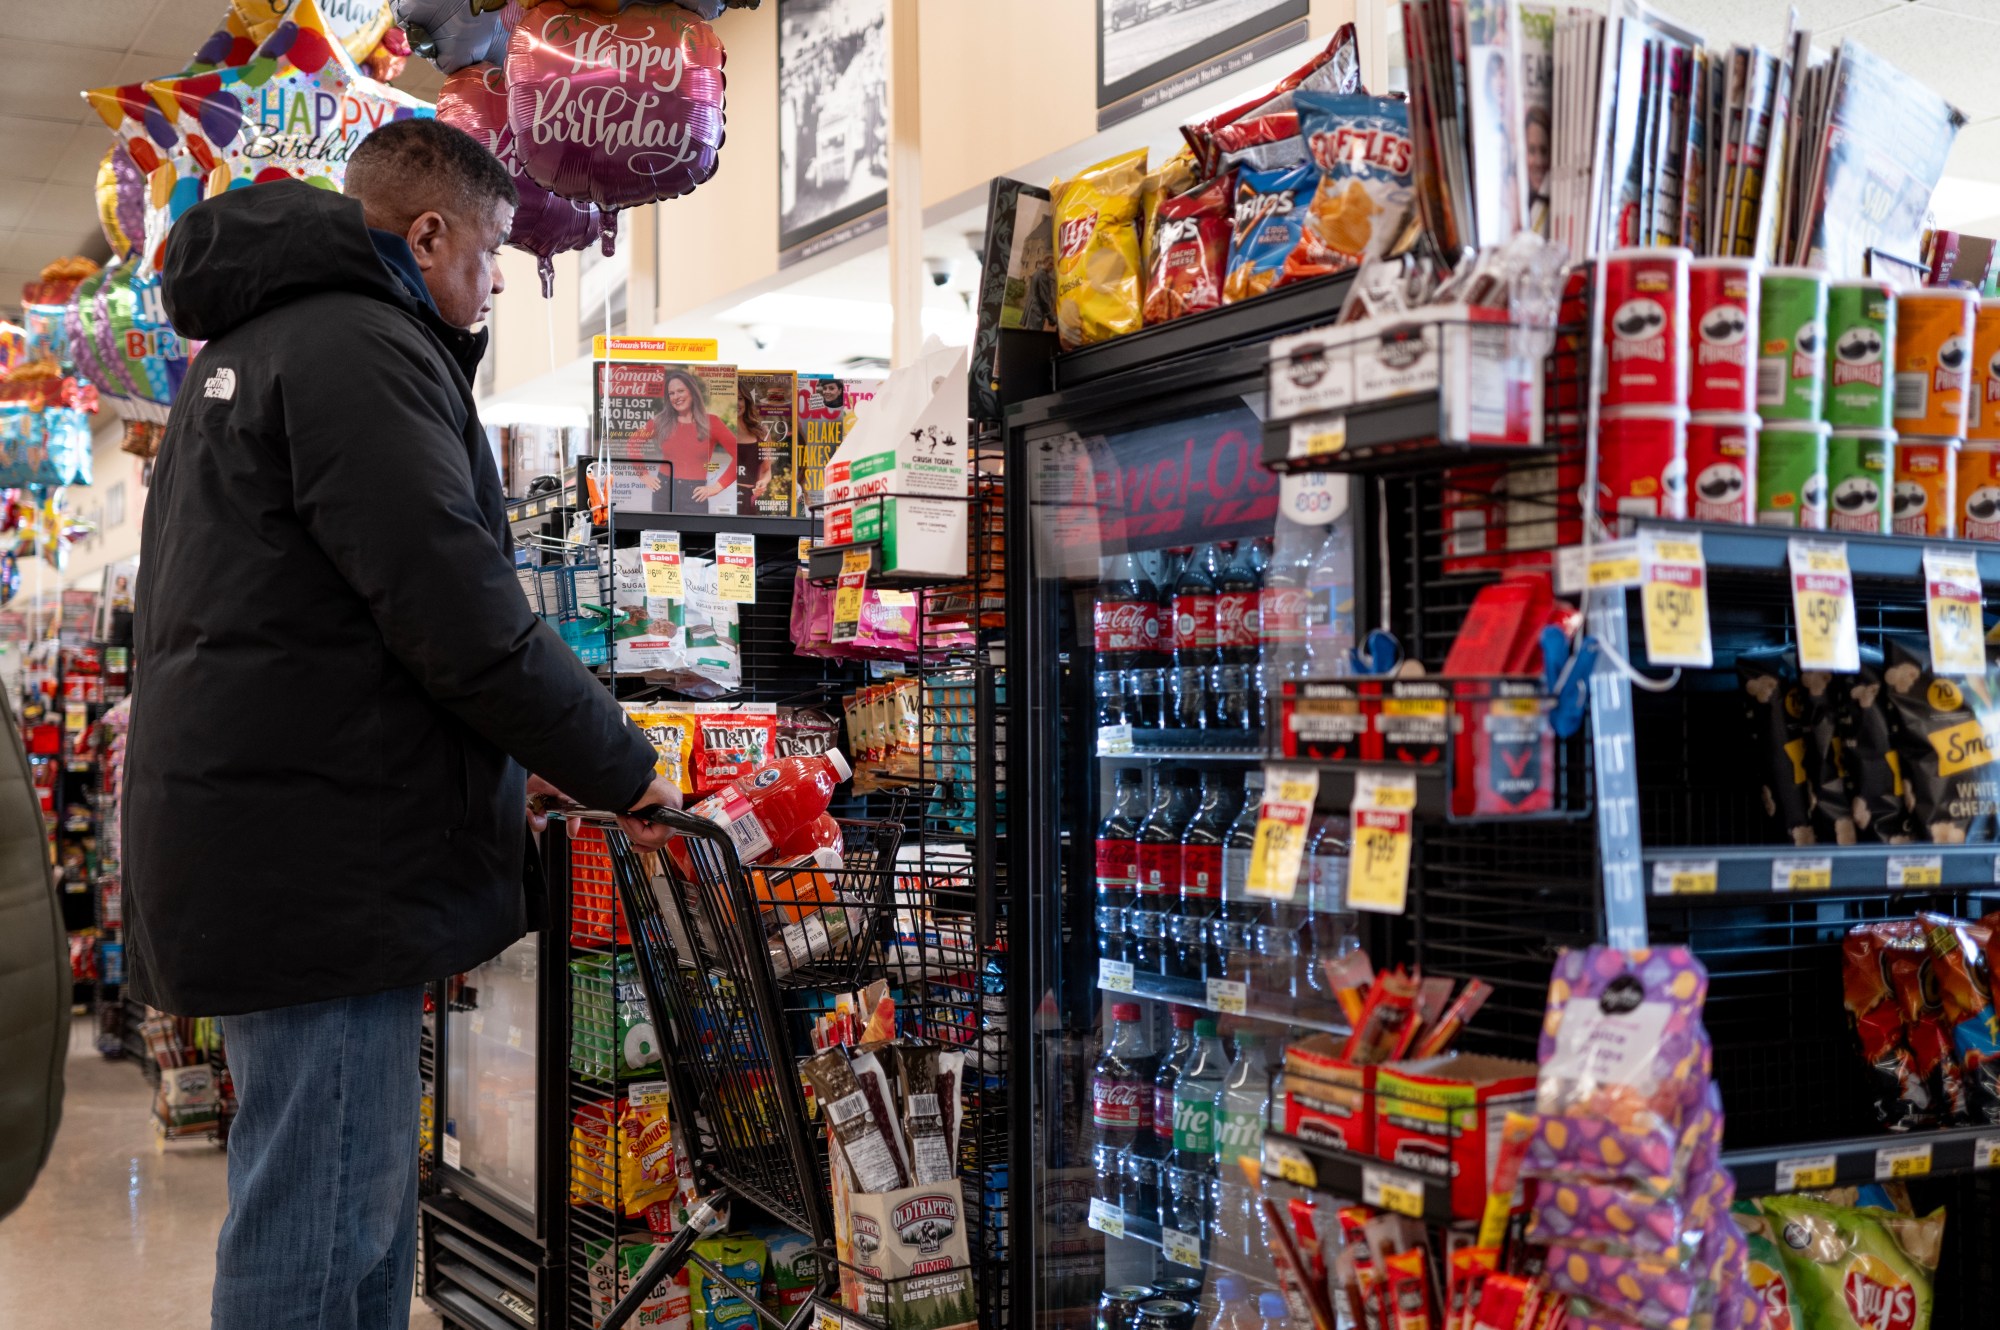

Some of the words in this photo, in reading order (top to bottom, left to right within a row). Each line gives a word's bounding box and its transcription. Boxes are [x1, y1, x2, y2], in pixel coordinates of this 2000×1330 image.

[542, 14, 683, 93] Happy
[260, 87, 385, 141] HAPPY
[532, 76, 698, 176] Birthday
[243, 122, 358, 163] Birthd
[1168, 257, 1195, 268] CHEESE
[1170, 248, 1196, 261] NACHO
[125, 328, 188, 361] BIRT
[640, 341, 665, 350] World
[1612, 335, 1665, 362] PRINGLES
[216, 367, 229, 379] THE
[600, 366, 665, 383] Woman's
[1834, 361, 1883, 387] PRINGLES
[204, 377, 223, 388] NORTH
[600, 382, 647, 396] World
[204, 388, 223, 398] FACE
[600, 399, 624, 408] SHE
[625, 399, 653, 408] LOST
[622, 408, 641, 420] lbs
[643, 410, 655, 420] IN
[608, 420, 615, 430] A
[616, 420, 647, 430] YEAR
[760, 420, 788, 442] 79
[807, 421, 842, 444] BLAKE
[797, 445, 831, 467] TAKES
[912, 456, 932, 464] CRUSH
[901, 462, 912, 470] THE
[1070, 430, 1280, 516] Jewel-Os
[804, 468, 825, 491] STA
[826, 486, 849, 511] CHOMP
[1831, 511, 1880, 534] PRINGLES
[1894, 514, 1927, 536] NGLES
[650, 554, 673, 562] Sale!
[724, 556, 747, 564] Sale!
[842, 575, 860, 586] Sale!
[1805, 577, 1841, 590] Sale!
[1935, 683, 1953, 699] 70
[1956, 781, 1999, 798] WHITE
[1093, 1082, 1137, 1106] Coca-Cola
[1174, 1101, 1210, 1132] ite
[628, 1118, 671, 1159] Starburs
[894, 1207, 912, 1228] OLD
[912, 1199, 956, 1220] TRAPPER
[913, 1258, 952, 1276] JUMBO
[907, 1272, 959, 1291] KIPPERED
[710, 1286, 757, 1304] PUNH
[902, 1289, 931, 1302] BEEF
[933, 1281, 966, 1296] STEAK
[718, 1305, 754, 1319] Gummie
